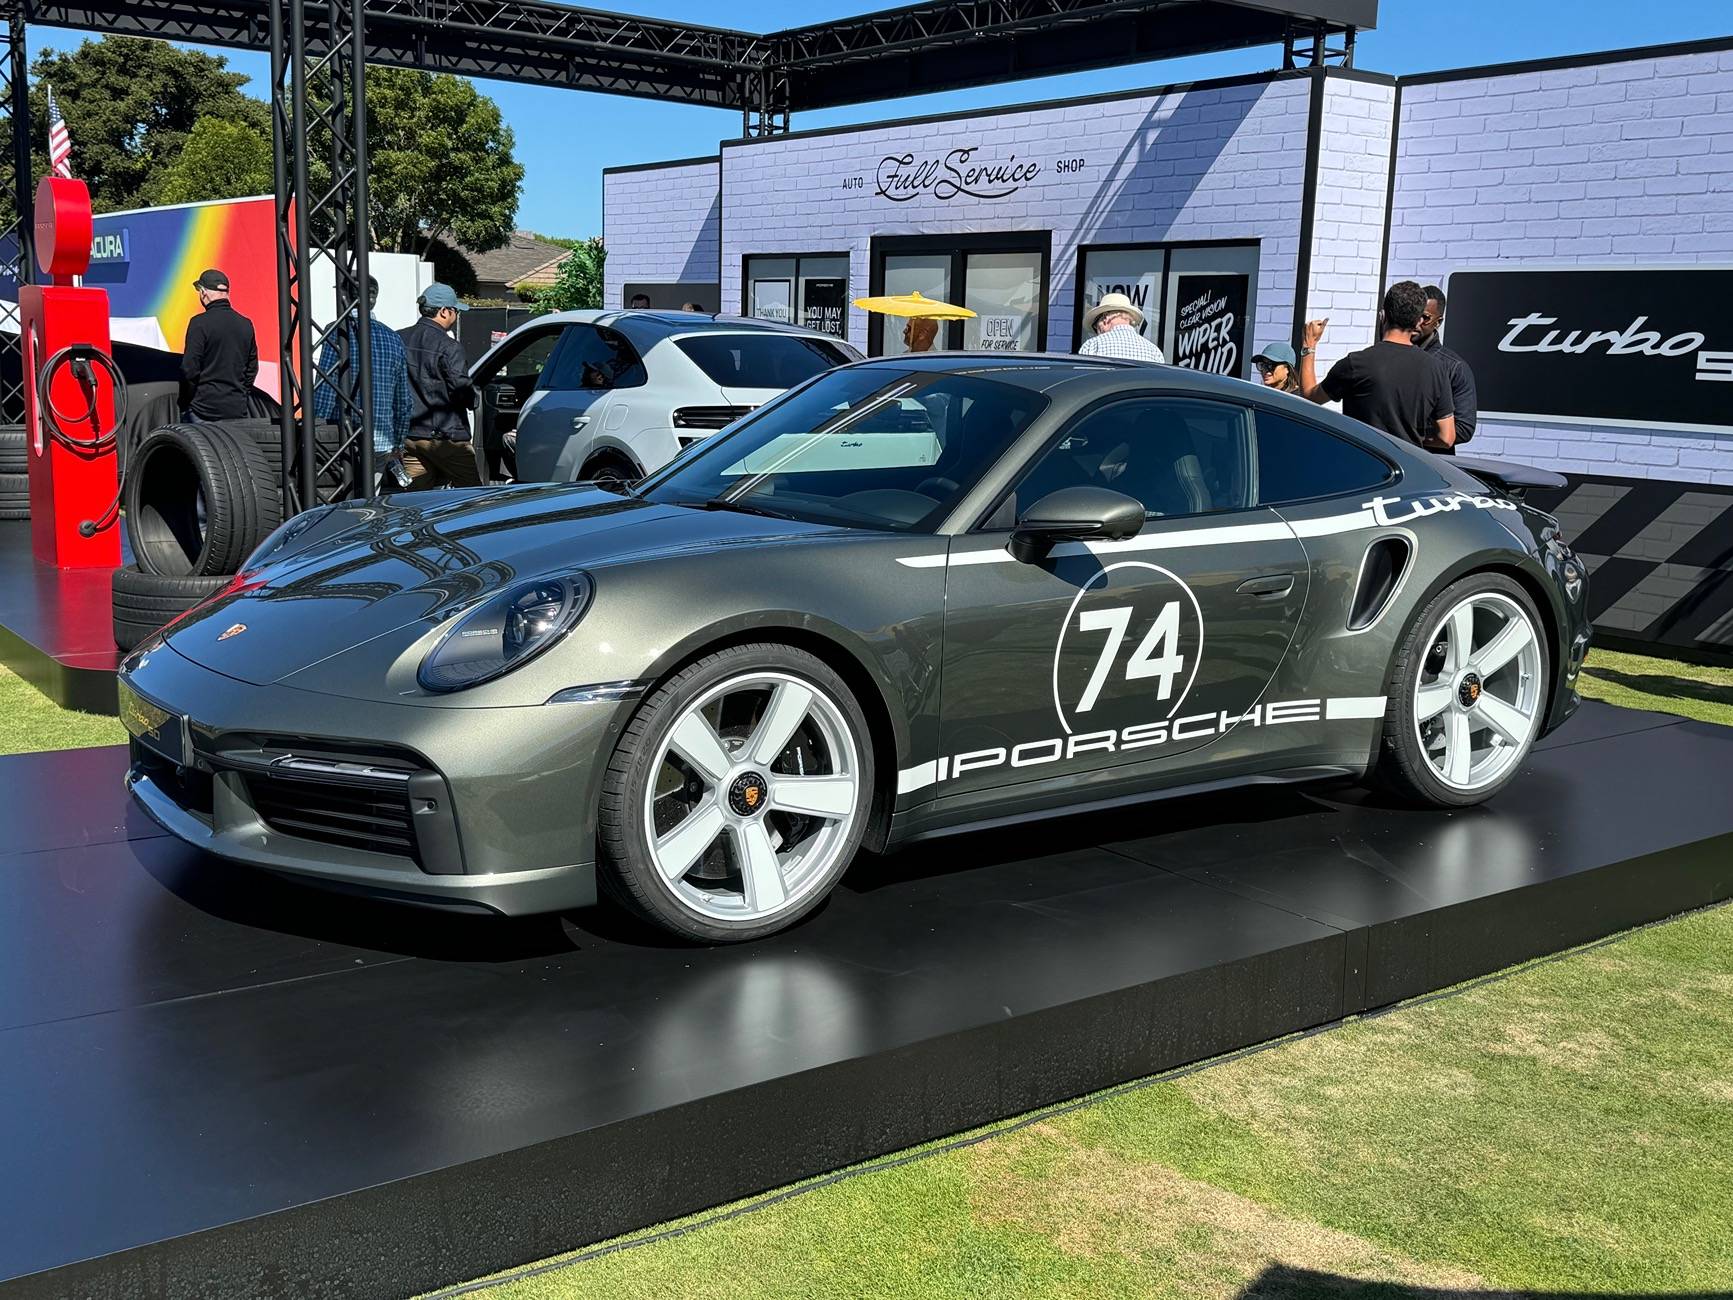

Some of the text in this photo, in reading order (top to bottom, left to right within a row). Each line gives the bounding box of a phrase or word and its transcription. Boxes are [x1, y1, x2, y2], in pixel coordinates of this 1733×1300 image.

[842, 147, 1085, 202] AUTO Full Service SHOP
[756, 307, 787, 318] THANK YOU
[806, 306, 842, 320] YOU MAY
[986, 318, 1014, 338] OPEN
[1180, 295, 1228, 329] CLEAR VISION
[981, 339, 1019, 351] FOR SERVICE
[1178, 312, 1235, 359] WIPER
[1497, 312, 1705, 356] turbo
[1178, 341, 1237, 376] UID
[1361, 491, 1517, 527] turbo
[1075, 601, 1185, 713] 74
[951, 698, 1321, 779] PORSCHE
